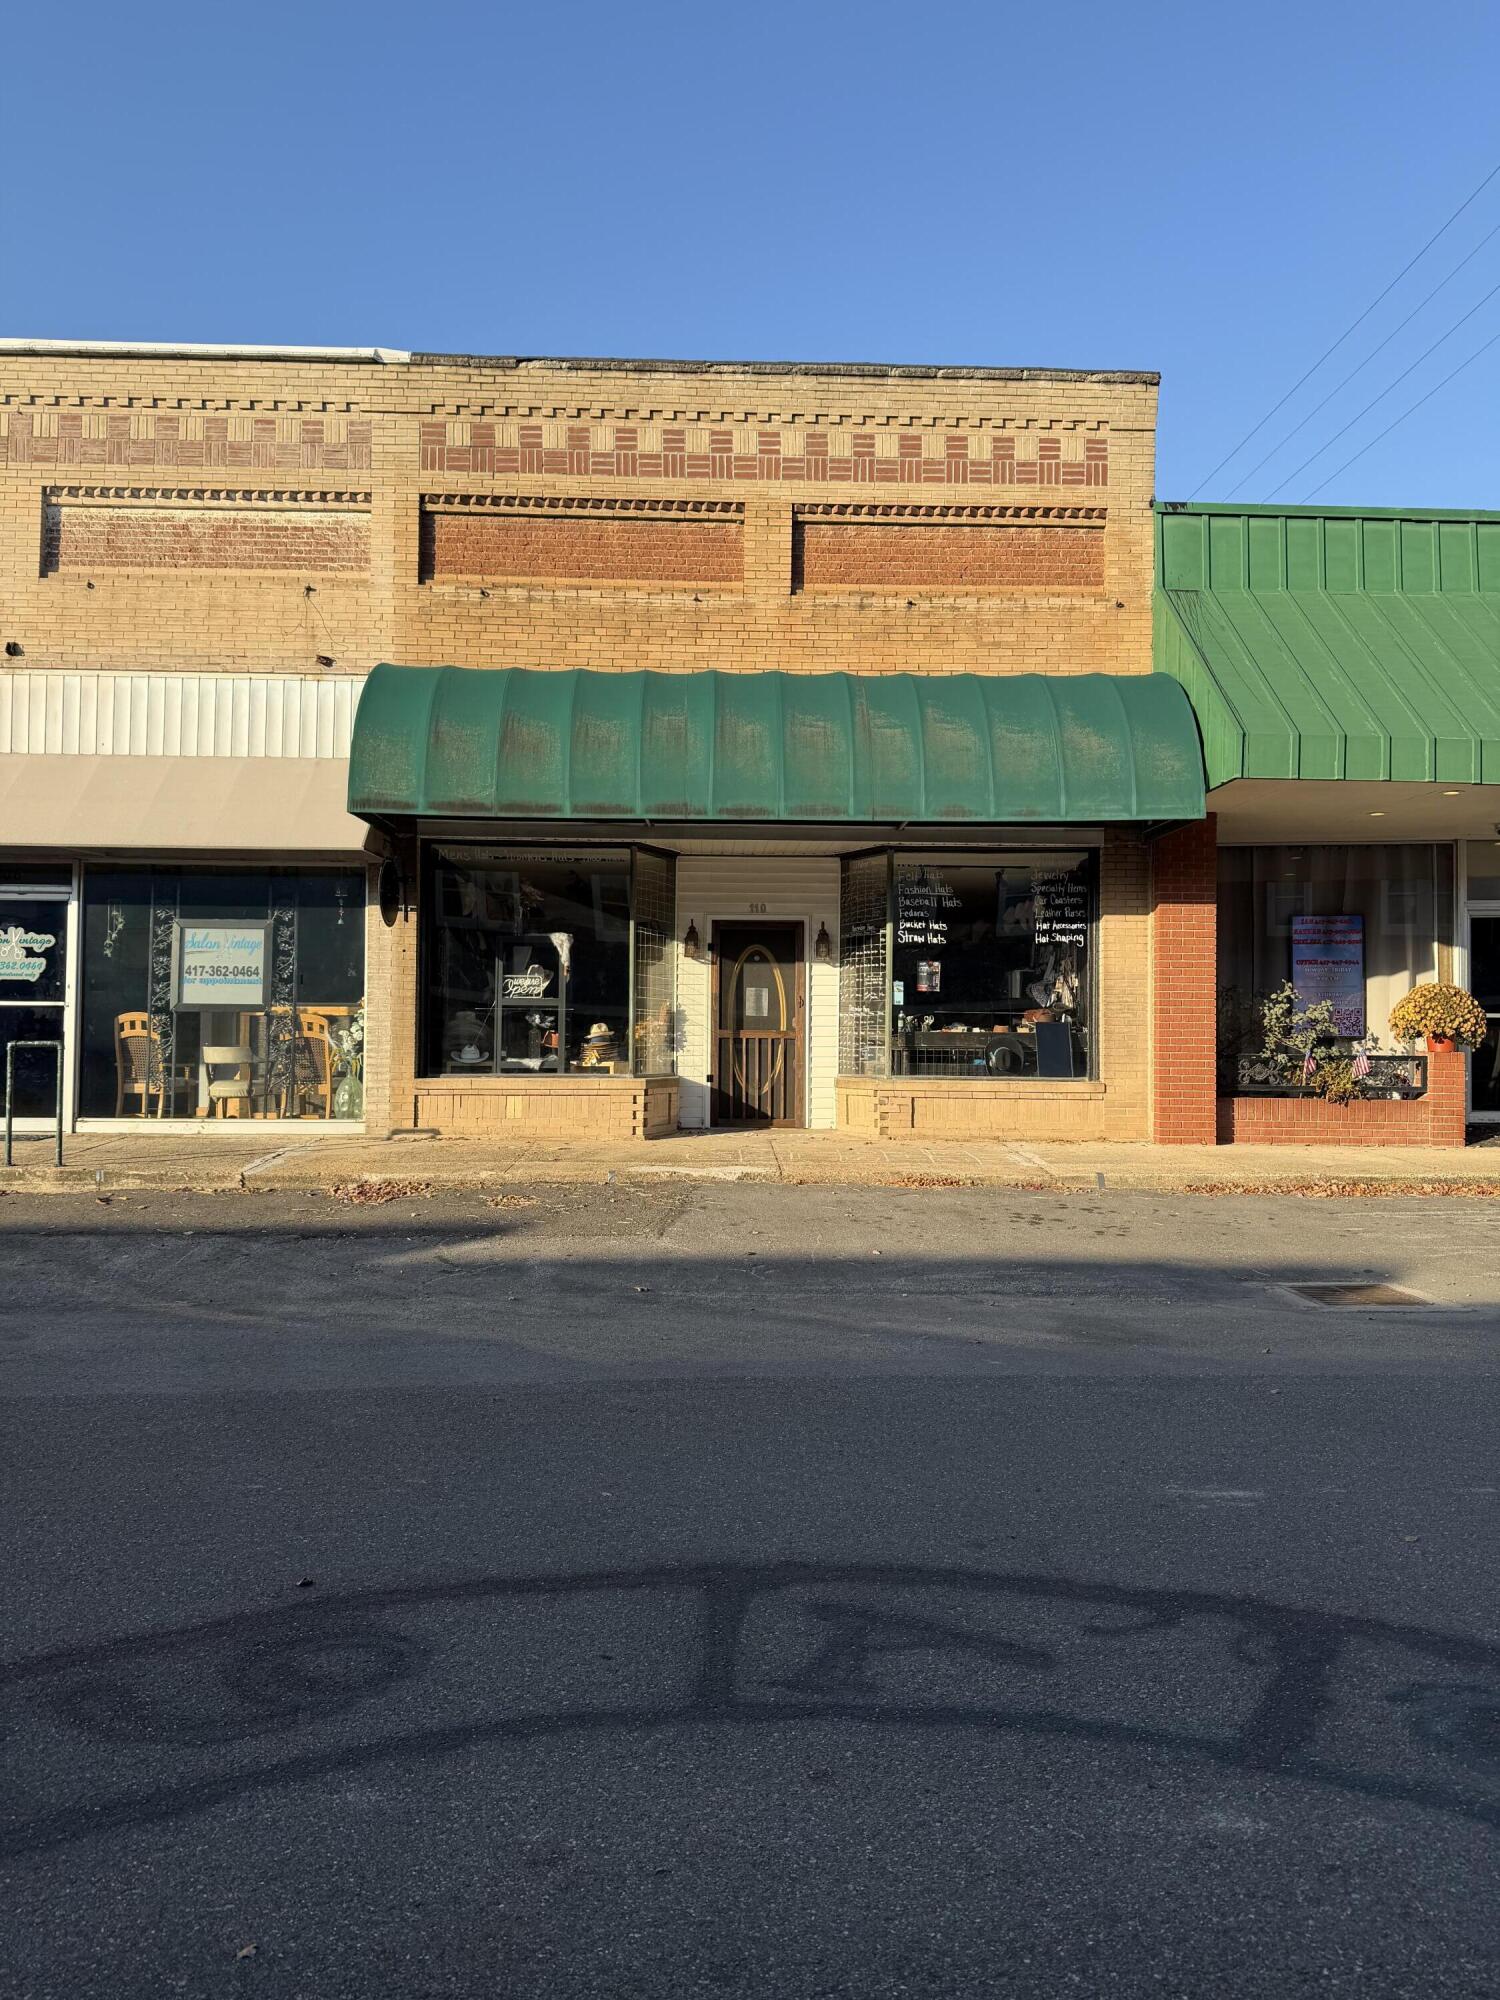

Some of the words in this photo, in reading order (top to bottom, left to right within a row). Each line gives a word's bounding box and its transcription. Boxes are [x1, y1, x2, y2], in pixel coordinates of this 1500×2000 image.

[1031, 871, 1069, 885] Jewelry
[898, 883, 931, 895] Fashion
[934, 883, 954, 893] Hats
[1031, 881, 1066, 896] Specialty
[898, 896, 938, 907] Baseball
[942, 896, 962, 908] Hats
[1050, 893, 1083, 905] Coasters
[1035, 908, 1061, 919] Leather
[899, 919, 926, 930] Bucket
[928, 920, 948, 931] Hats
[1036, 920, 1050, 932] Hat
[1052, 920, 1087, 931] Accessories
[184, 930, 220, 950] Salon
[897, 930, 925, 943] Straw
[927, 932, 947, 944] Hats
[1035, 932, 1049, 944] Hat
[1051, 933, 1084, 947] Shaping
[0, 962, 43, 970] 362.0464
[185, 965, 260, 977] 417-362-0464
[183, 976, 197, 985] for
[503, 978, 541, 998] Open
